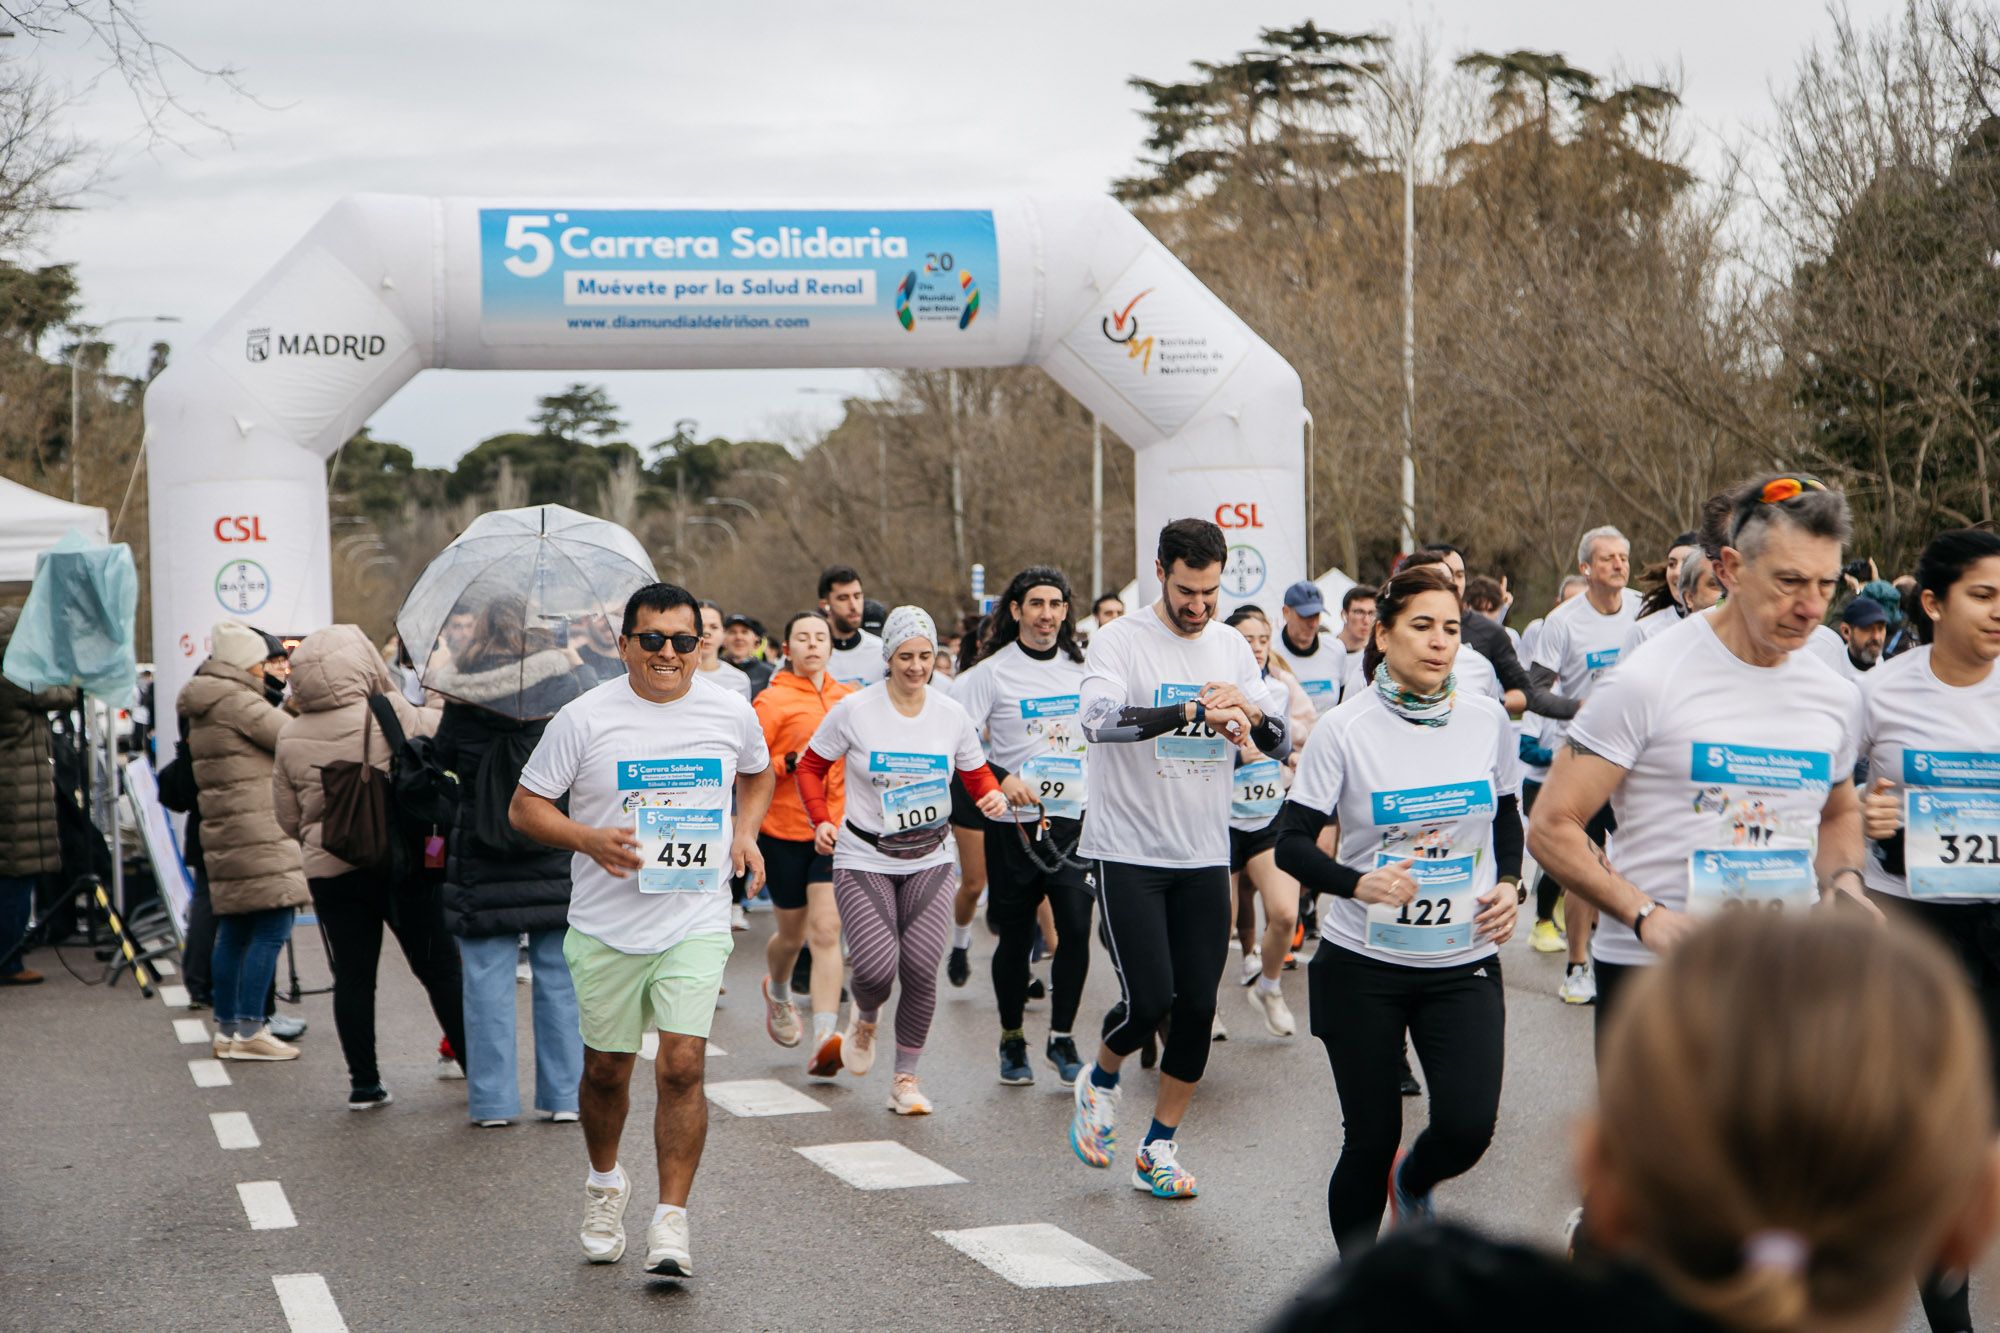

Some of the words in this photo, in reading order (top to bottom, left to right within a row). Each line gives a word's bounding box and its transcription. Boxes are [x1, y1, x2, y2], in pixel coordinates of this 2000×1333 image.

[560, 226, 719, 259] Carrera
[730, 225, 907, 259] Solidaria
[925, 252, 954, 272] 20
[578, 277, 667, 297] Muévete
[673, 281, 708, 300] por
[715, 277, 735, 296] la
[741, 277, 800, 296] Salud
[806, 277, 863, 295] Renal
[567, 315, 810, 330] www.diamundialdelriñon.com
[278, 335, 386, 360] MADRID
[1215, 503, 1264, 529] CSL
[213, 516, 267, 542] CSL
[640, 766, 669, 774] Carrera
[671, 764, 704, 773] Solidaria
[695, 778, 720, 788] 2026
[1040, 780, 1065, 798] 99
[1244, 783, 1276, 801] 196
[1397, 795, 1434, 805] Carrera
[1435, 789, 1475, 801] Solidaria
[897, 806, 937, 831] 100
[657, 842, 707, 867] 434
[1940, 834, 2000, 864] 321
[1397, 898, 1452, 926] 122
